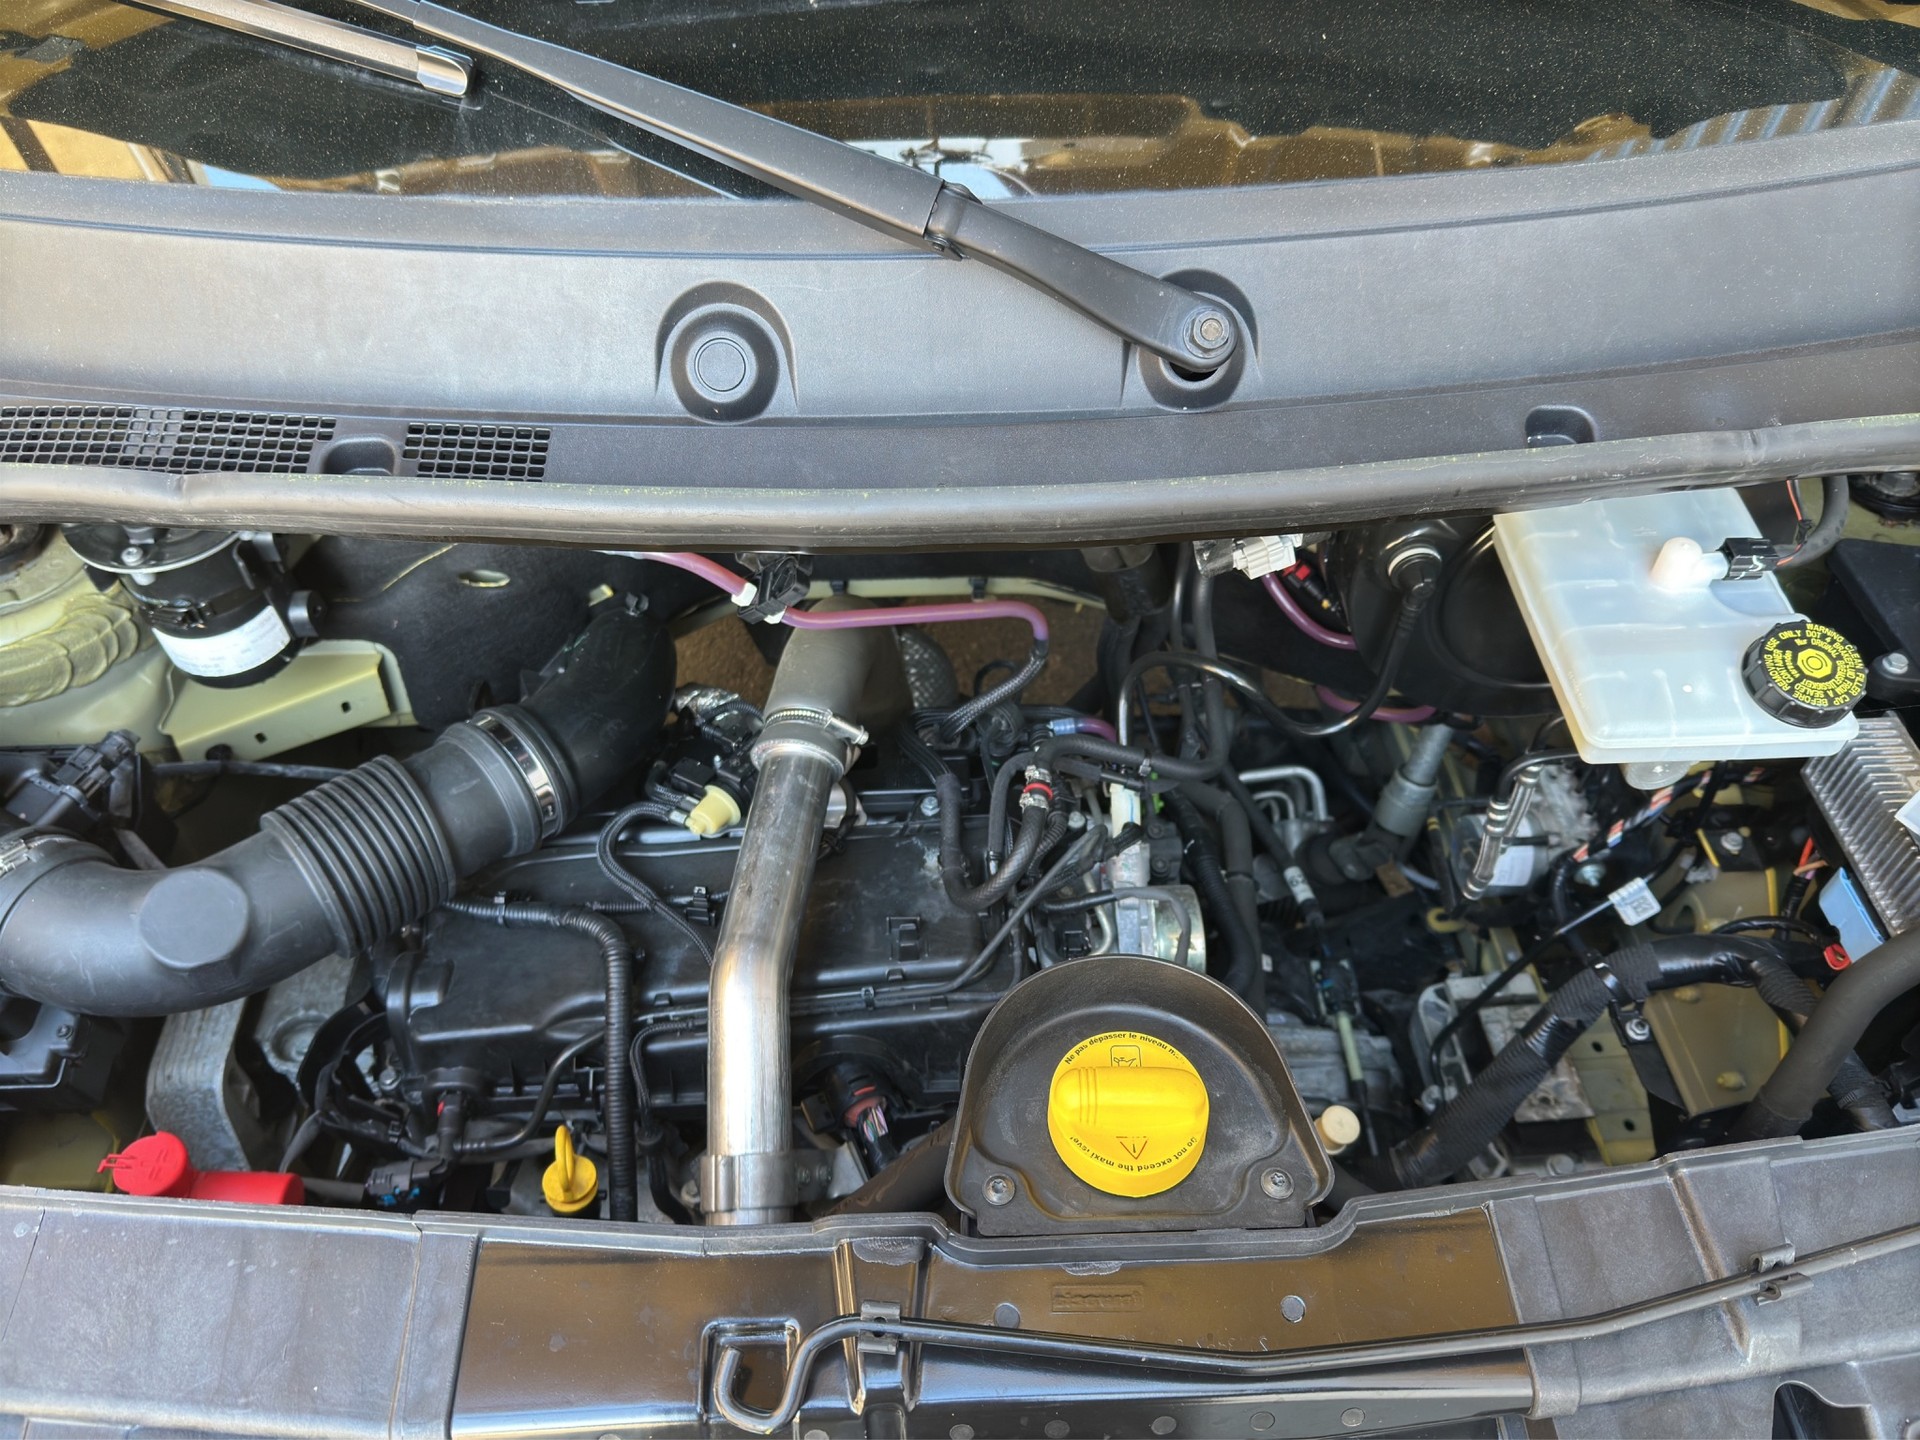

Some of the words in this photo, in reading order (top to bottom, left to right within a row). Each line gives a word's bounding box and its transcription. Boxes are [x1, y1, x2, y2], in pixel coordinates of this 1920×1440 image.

[1779, 630, 1801, 639] ONLY
[1806, 624, 1844, 642] WARNING
[1806, 630, 1822, 638] DOT
[1765, 638, 1780, 651] USE
[1845, 645, 1864, 669] CLEAN
[1764, 654, 1791, 691] REMOVING
[1773, 649, 1794, 683] CONTAINER
[1794, 683, 1824, 698] SEALED
[1835, 680, 1852, 695] FROM
[1849, 672, 1865, 696] FILLER
[1793, 692, 1828, 706] BEFORE
[1834, 695, 1850, 705] CAP
[1065, 1054, 1075, 1064] Ne
[1075, 1045, 1088, 1056] pas
[1140, 1036, 1167, 1049] niveau
[1090, 1153, 1114, 1166] maxi
[1174, 1147, 1187, 1159] not
[1118, 1163, 1133, 1171] the
[1137, 1158, 1172, 1171] exceed
